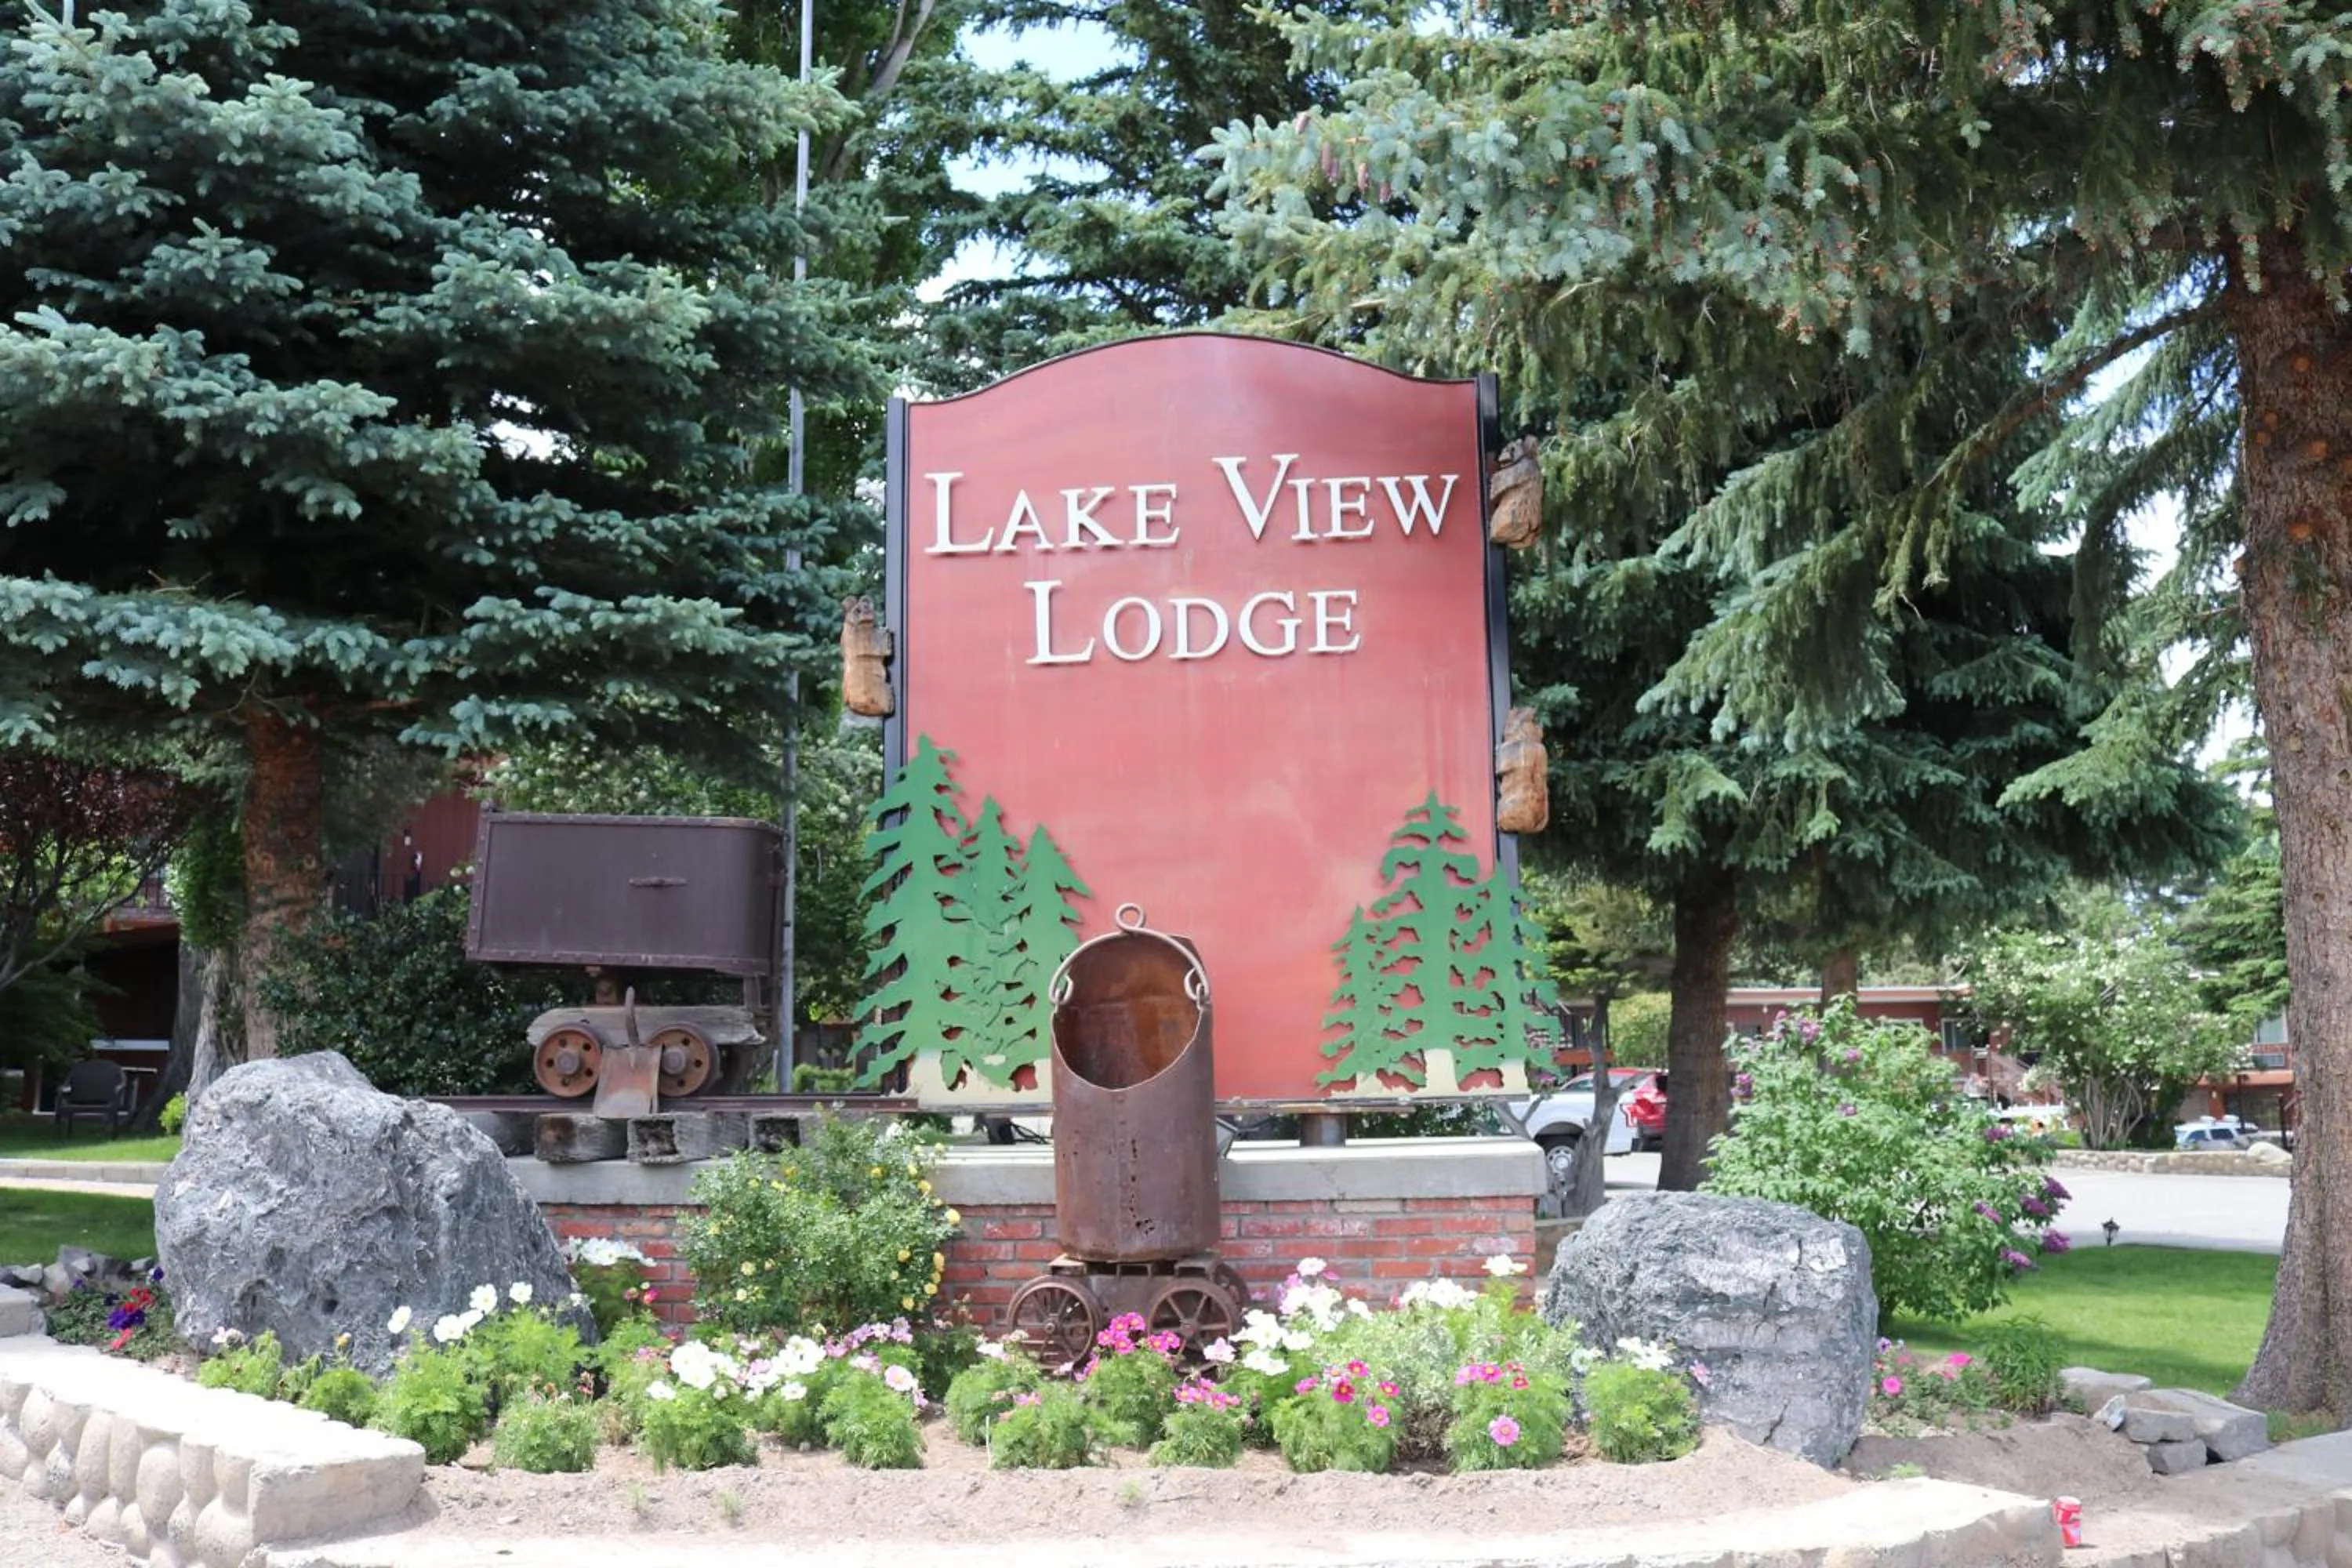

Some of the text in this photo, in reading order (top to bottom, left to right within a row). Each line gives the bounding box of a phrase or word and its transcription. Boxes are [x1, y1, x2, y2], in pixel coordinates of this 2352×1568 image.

[924, 453, 1459, 555] LAKE VIEW
[1023, 579, 1361, 665] LODGE
